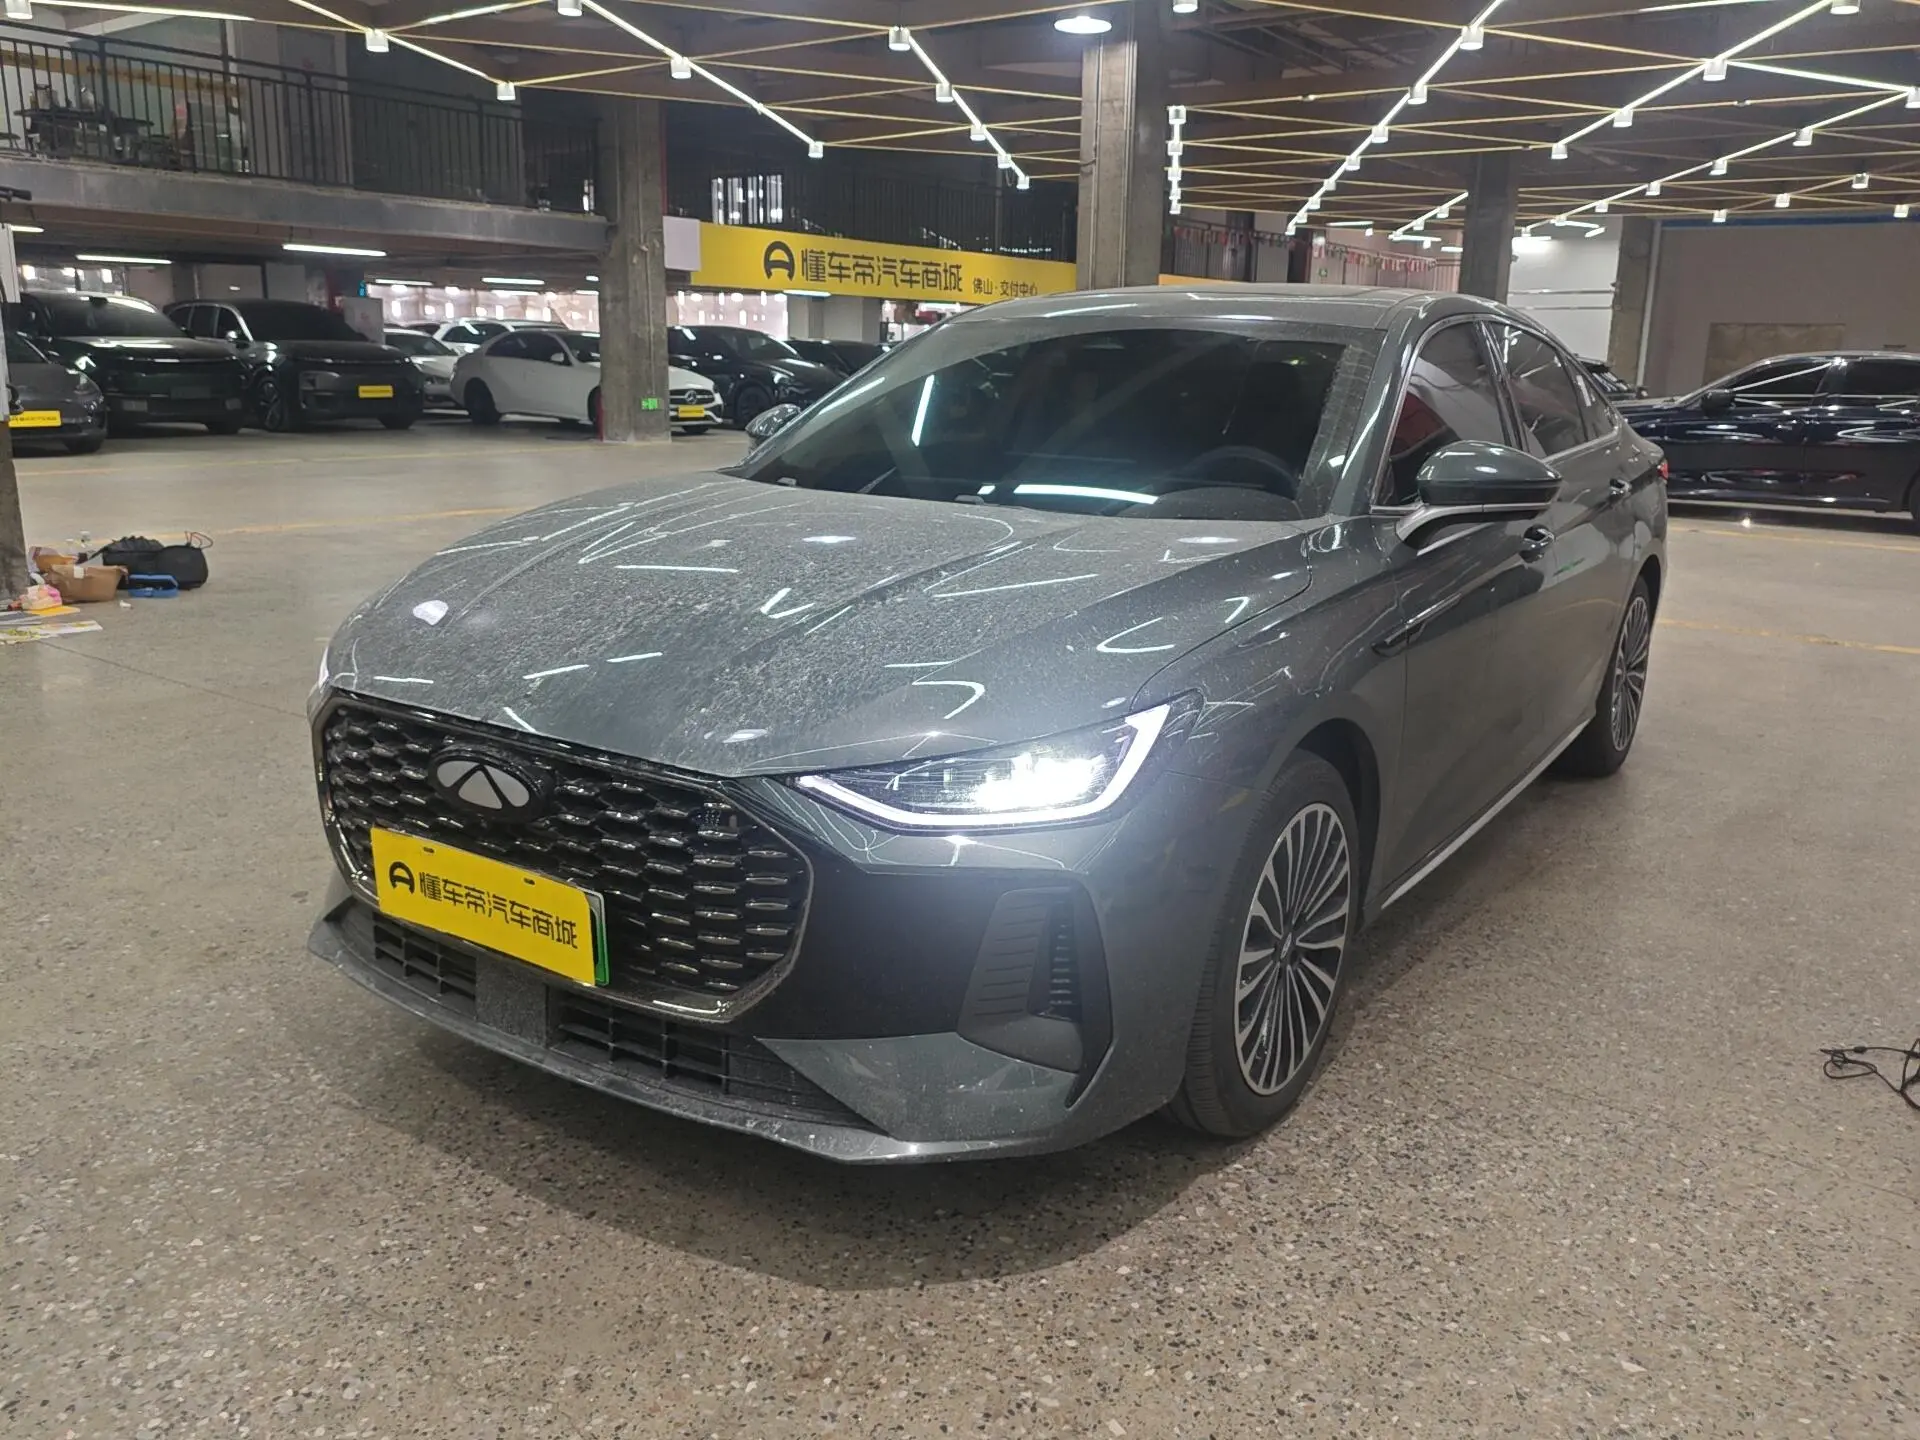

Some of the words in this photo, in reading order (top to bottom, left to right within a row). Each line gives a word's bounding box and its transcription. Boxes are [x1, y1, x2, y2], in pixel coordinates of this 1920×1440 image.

[801, 249, 963, 293] 懂车帝汽车商城
[418, 871, 578, 949] 懂车帝汽车商城
